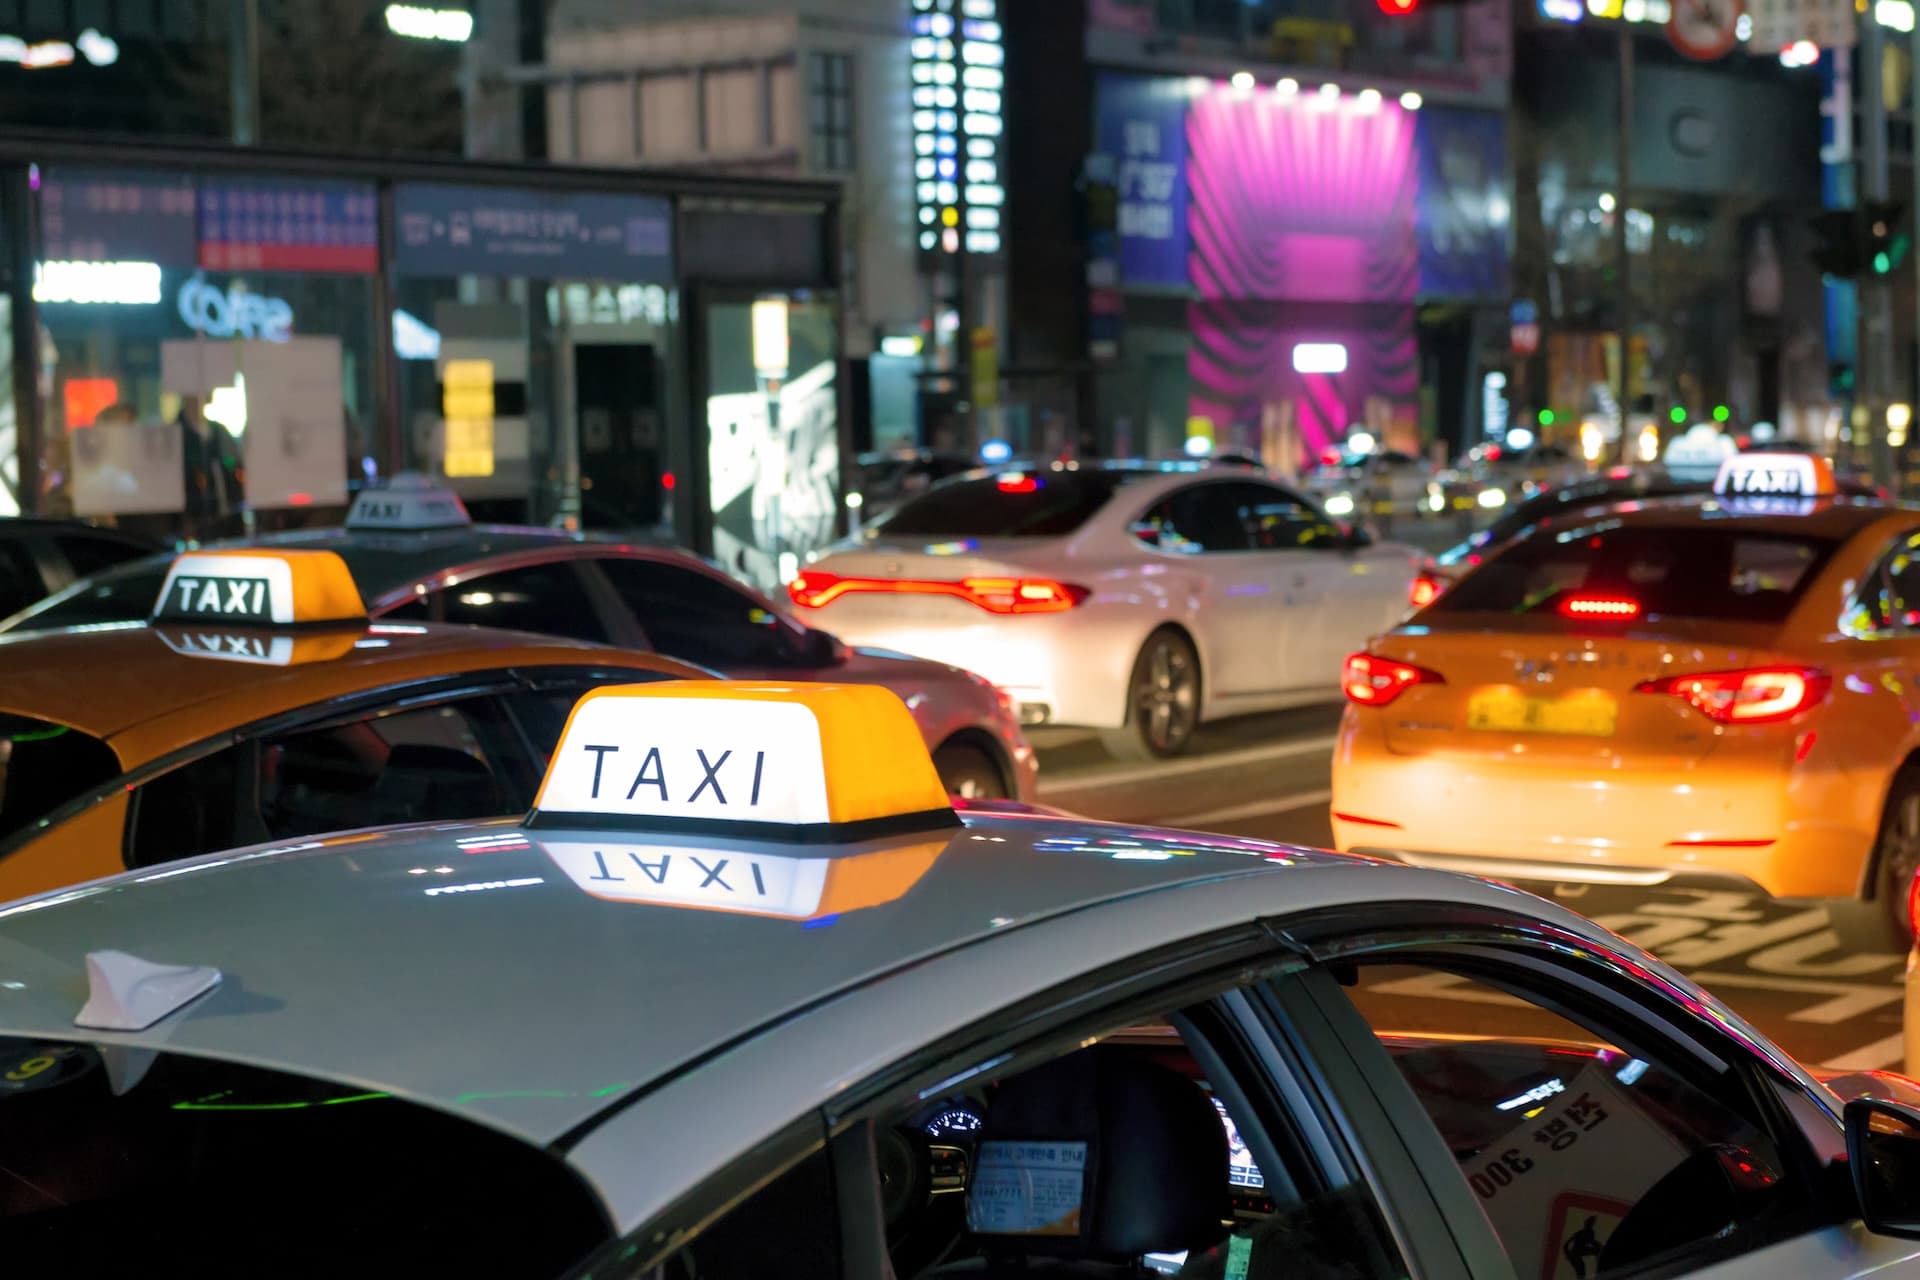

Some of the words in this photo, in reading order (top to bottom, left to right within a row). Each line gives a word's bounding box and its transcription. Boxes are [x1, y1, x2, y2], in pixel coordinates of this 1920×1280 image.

[1732, 470, 1799, 494] TAXI
[359, 502, 403, 520] TAXI
[178, 579, 265, 615] TAXI
[584, 744, 765, 806] TAXI
